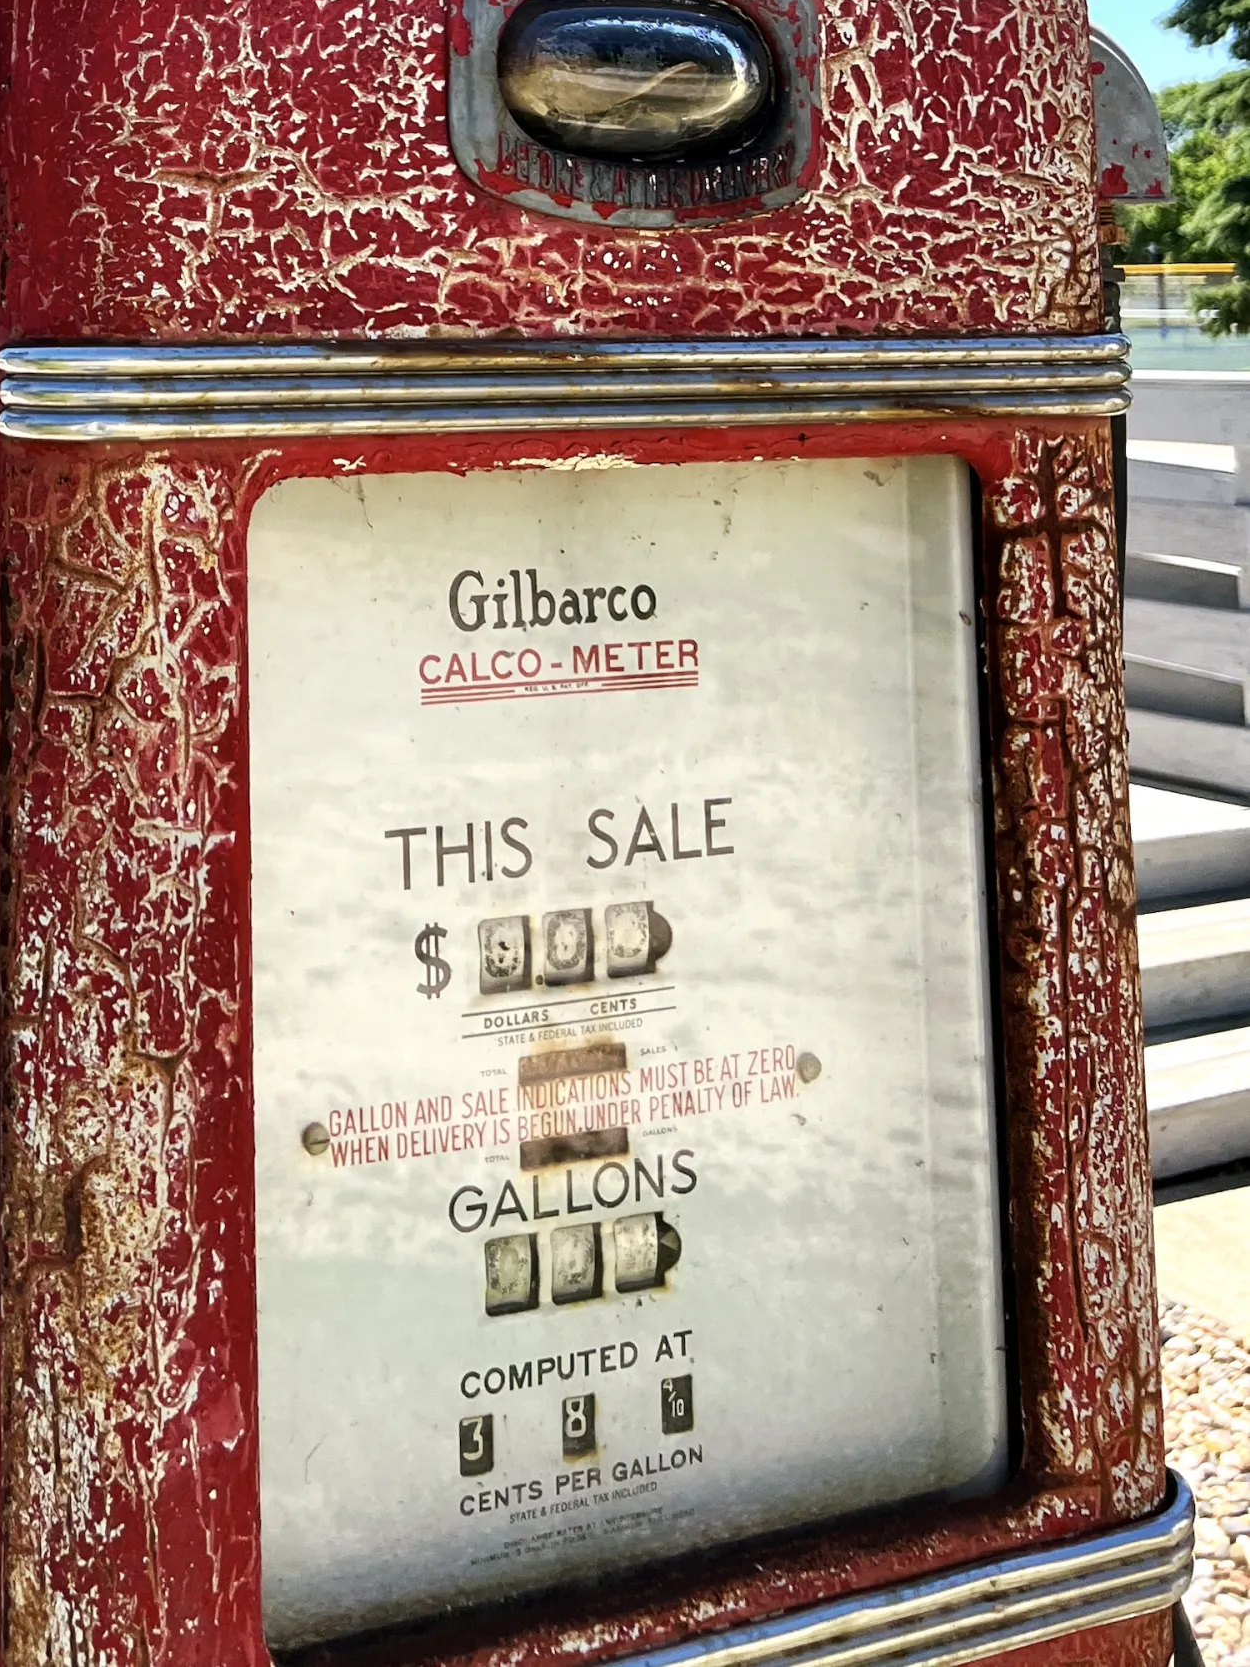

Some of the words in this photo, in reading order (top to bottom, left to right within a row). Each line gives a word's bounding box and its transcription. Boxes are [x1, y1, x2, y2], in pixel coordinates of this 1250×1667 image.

[449, 568, 657, 632] Gilbarco
[384, 817, 533, 891] THIS
[586, 797, 735, 870] SALE
[484, 1008, 550, 1030] DOLLARS
[589, 997, 638, 1016] CENTS
[497, 1033, 526, 1047] STATE
[529, 1031, 536, 1043] &
[538, 1026, 578, 1042] FEDERAL
[580, 1023, 596, 1036] TAX
[599, 1017, 644, 1033] INCLUDED
[329, 1100, 408, 1137] GALLON
[414, 1094, 453, 1126] AND
[461, 1086, 510, 1120] SALE
[516, 1069, 632, 1112] INDICATIONS
[640, 1061, 688, 1093] MUST
[694, 1056, 715, 1086] BE
[720, 1052, 742, 1082] AT
[747, 1043, 797, 1077] ZERO
[480, 1067, 508, 1079] TOTAL
[640, 1044, 667, 1057] SALES
[330, 1133, 389, 1169] WHEN
[397, 1119, 488, 1160] DELIVERY
[493, 1117, 511, 1147] IS
[584, 1098, 642, 1132] UNDER
[649, 1084, 726, 1122] PENALTY
[731, 1080, 753, 1109] OF
[760, 1072, 801, 1104] LAW.
[449, 1148, 698, 1234] GALLONS
[483, 1153, 511, 1165] TOTAL
[460, 1340, 639, 1399] COMPUTED
[654, 1329, 694, 1363] AT
[462, 1417, 485, 1461] 3
[565, 1396, 587, 1439] 8
[459, 1480, 544, 1517] CENTS
[555, 1466, 602, 1496] PER
[611, 1443, 703, 1483] GALLON
[509, 1507, 538, 1525] STATE
[550, 1497, 590, 1515] FEDERAL
[593, 1491, 610, 1505] TAX
[612, 1481, 658, 1502] INCLUDED
